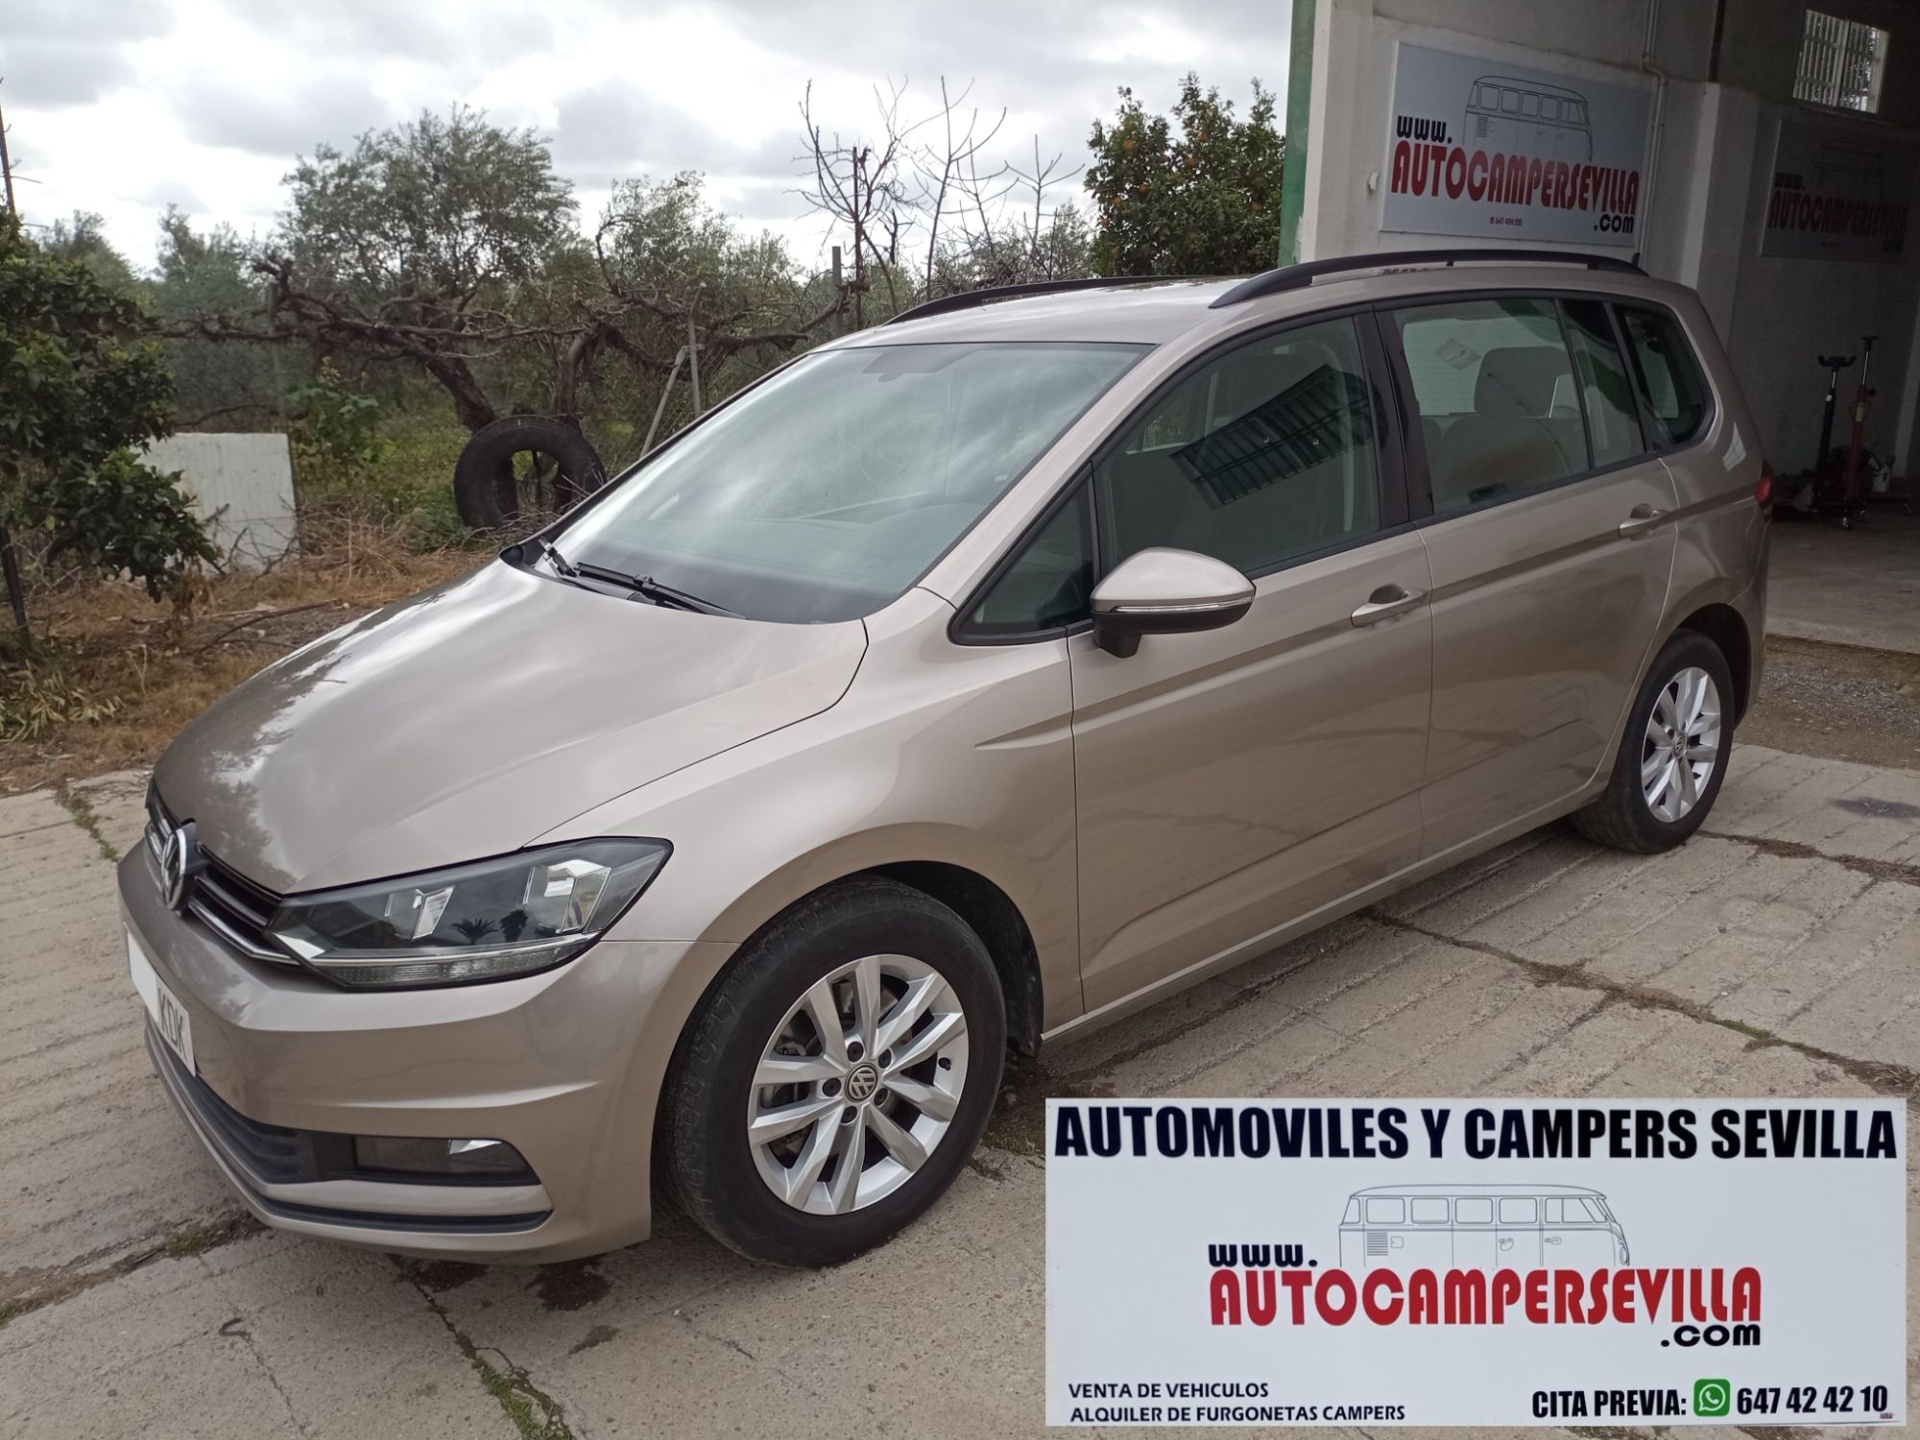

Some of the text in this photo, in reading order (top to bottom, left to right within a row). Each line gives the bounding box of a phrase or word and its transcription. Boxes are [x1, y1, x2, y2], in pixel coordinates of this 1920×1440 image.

[1396, 115, 1452, 144] www.
[1391, 140, 1639, 217] AUTOCAMPERSEVILLA
[1593, 213, 1634, 234] .com
